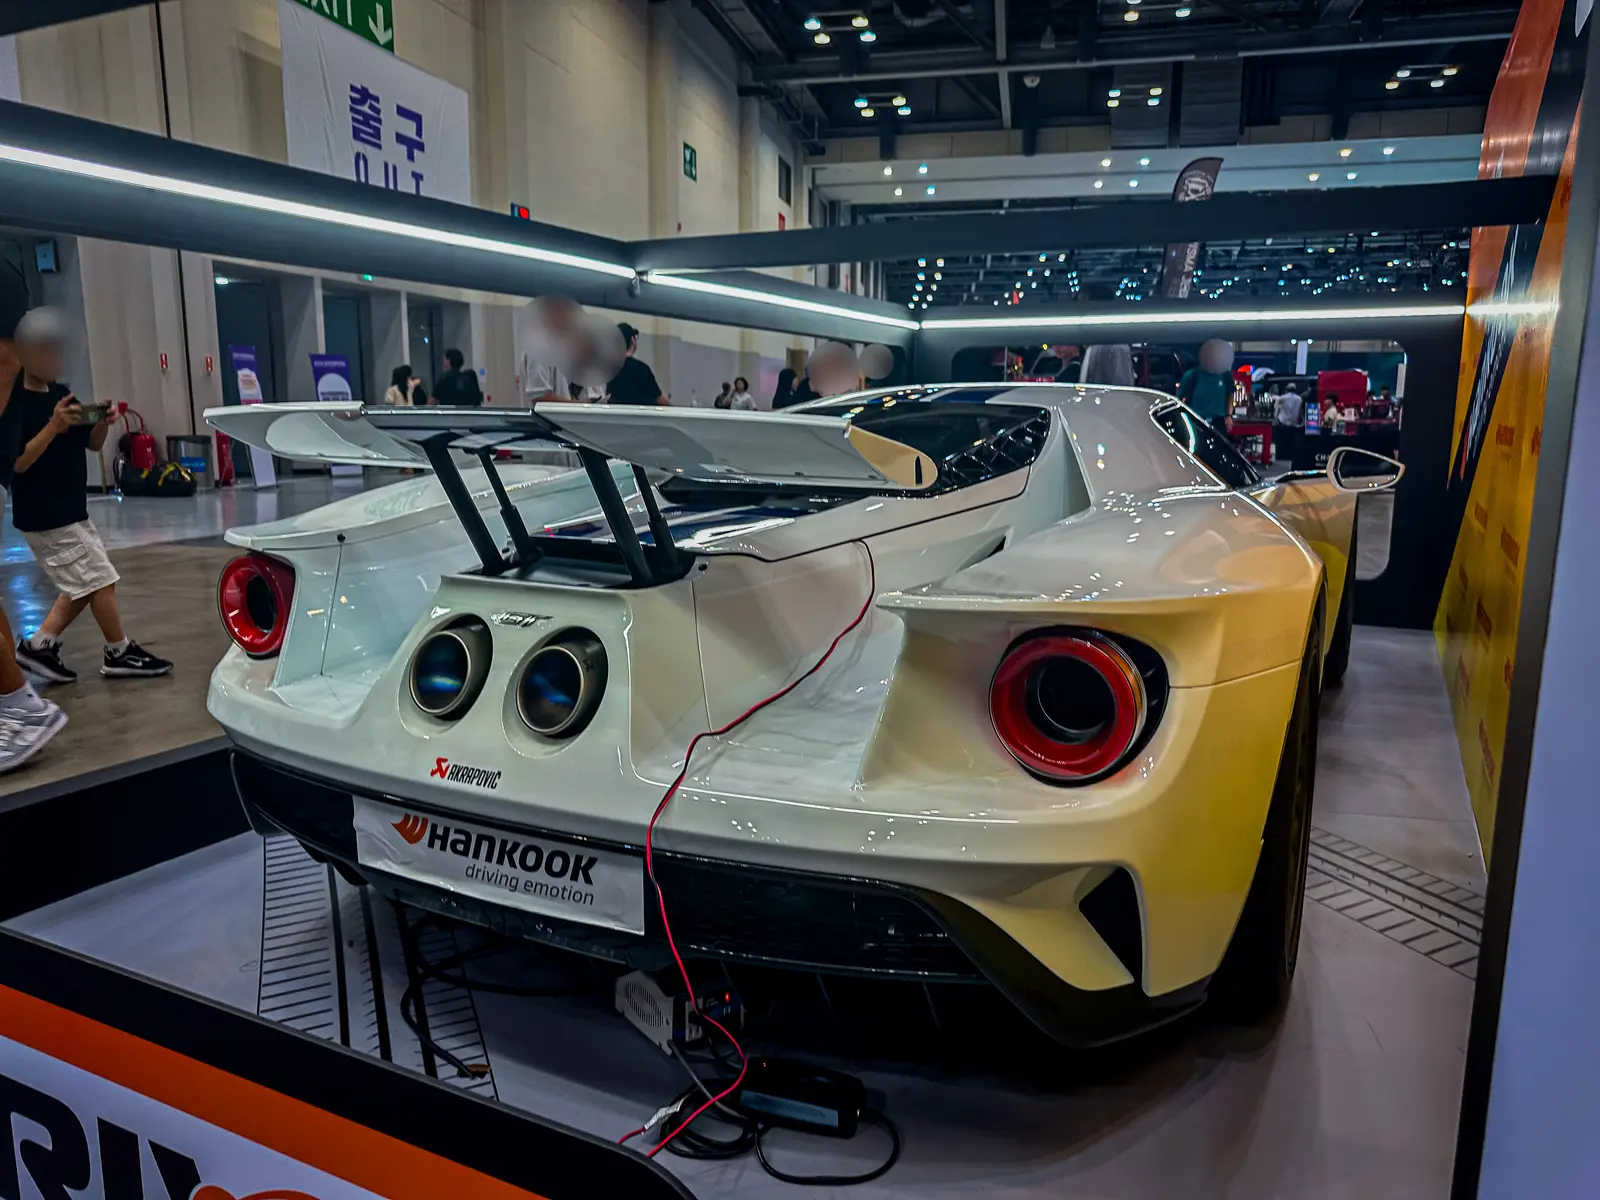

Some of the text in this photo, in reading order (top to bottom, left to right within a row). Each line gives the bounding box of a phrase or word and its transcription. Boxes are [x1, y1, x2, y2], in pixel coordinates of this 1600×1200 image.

[348, 83, 425, 163] 출구
[465, 863, 595, 906] driving emotion
